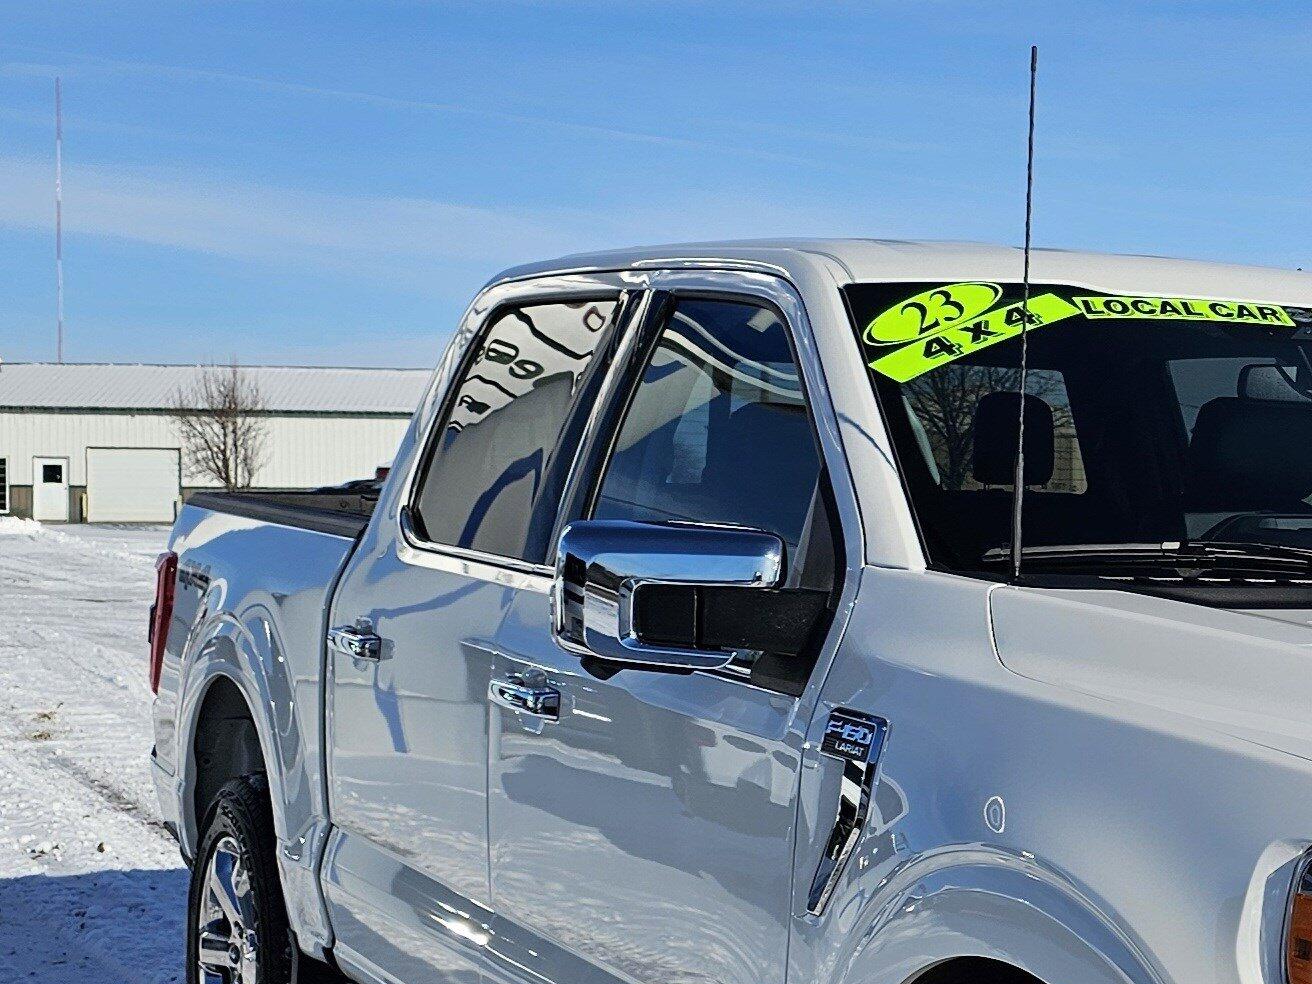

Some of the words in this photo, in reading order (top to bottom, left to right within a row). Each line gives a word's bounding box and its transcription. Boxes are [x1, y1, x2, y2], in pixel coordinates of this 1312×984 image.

[901, 290, 964, 335] 23
[1081, 299, 1205, 319] LOCAL
[1208, 303, 1284, 323] CAR
